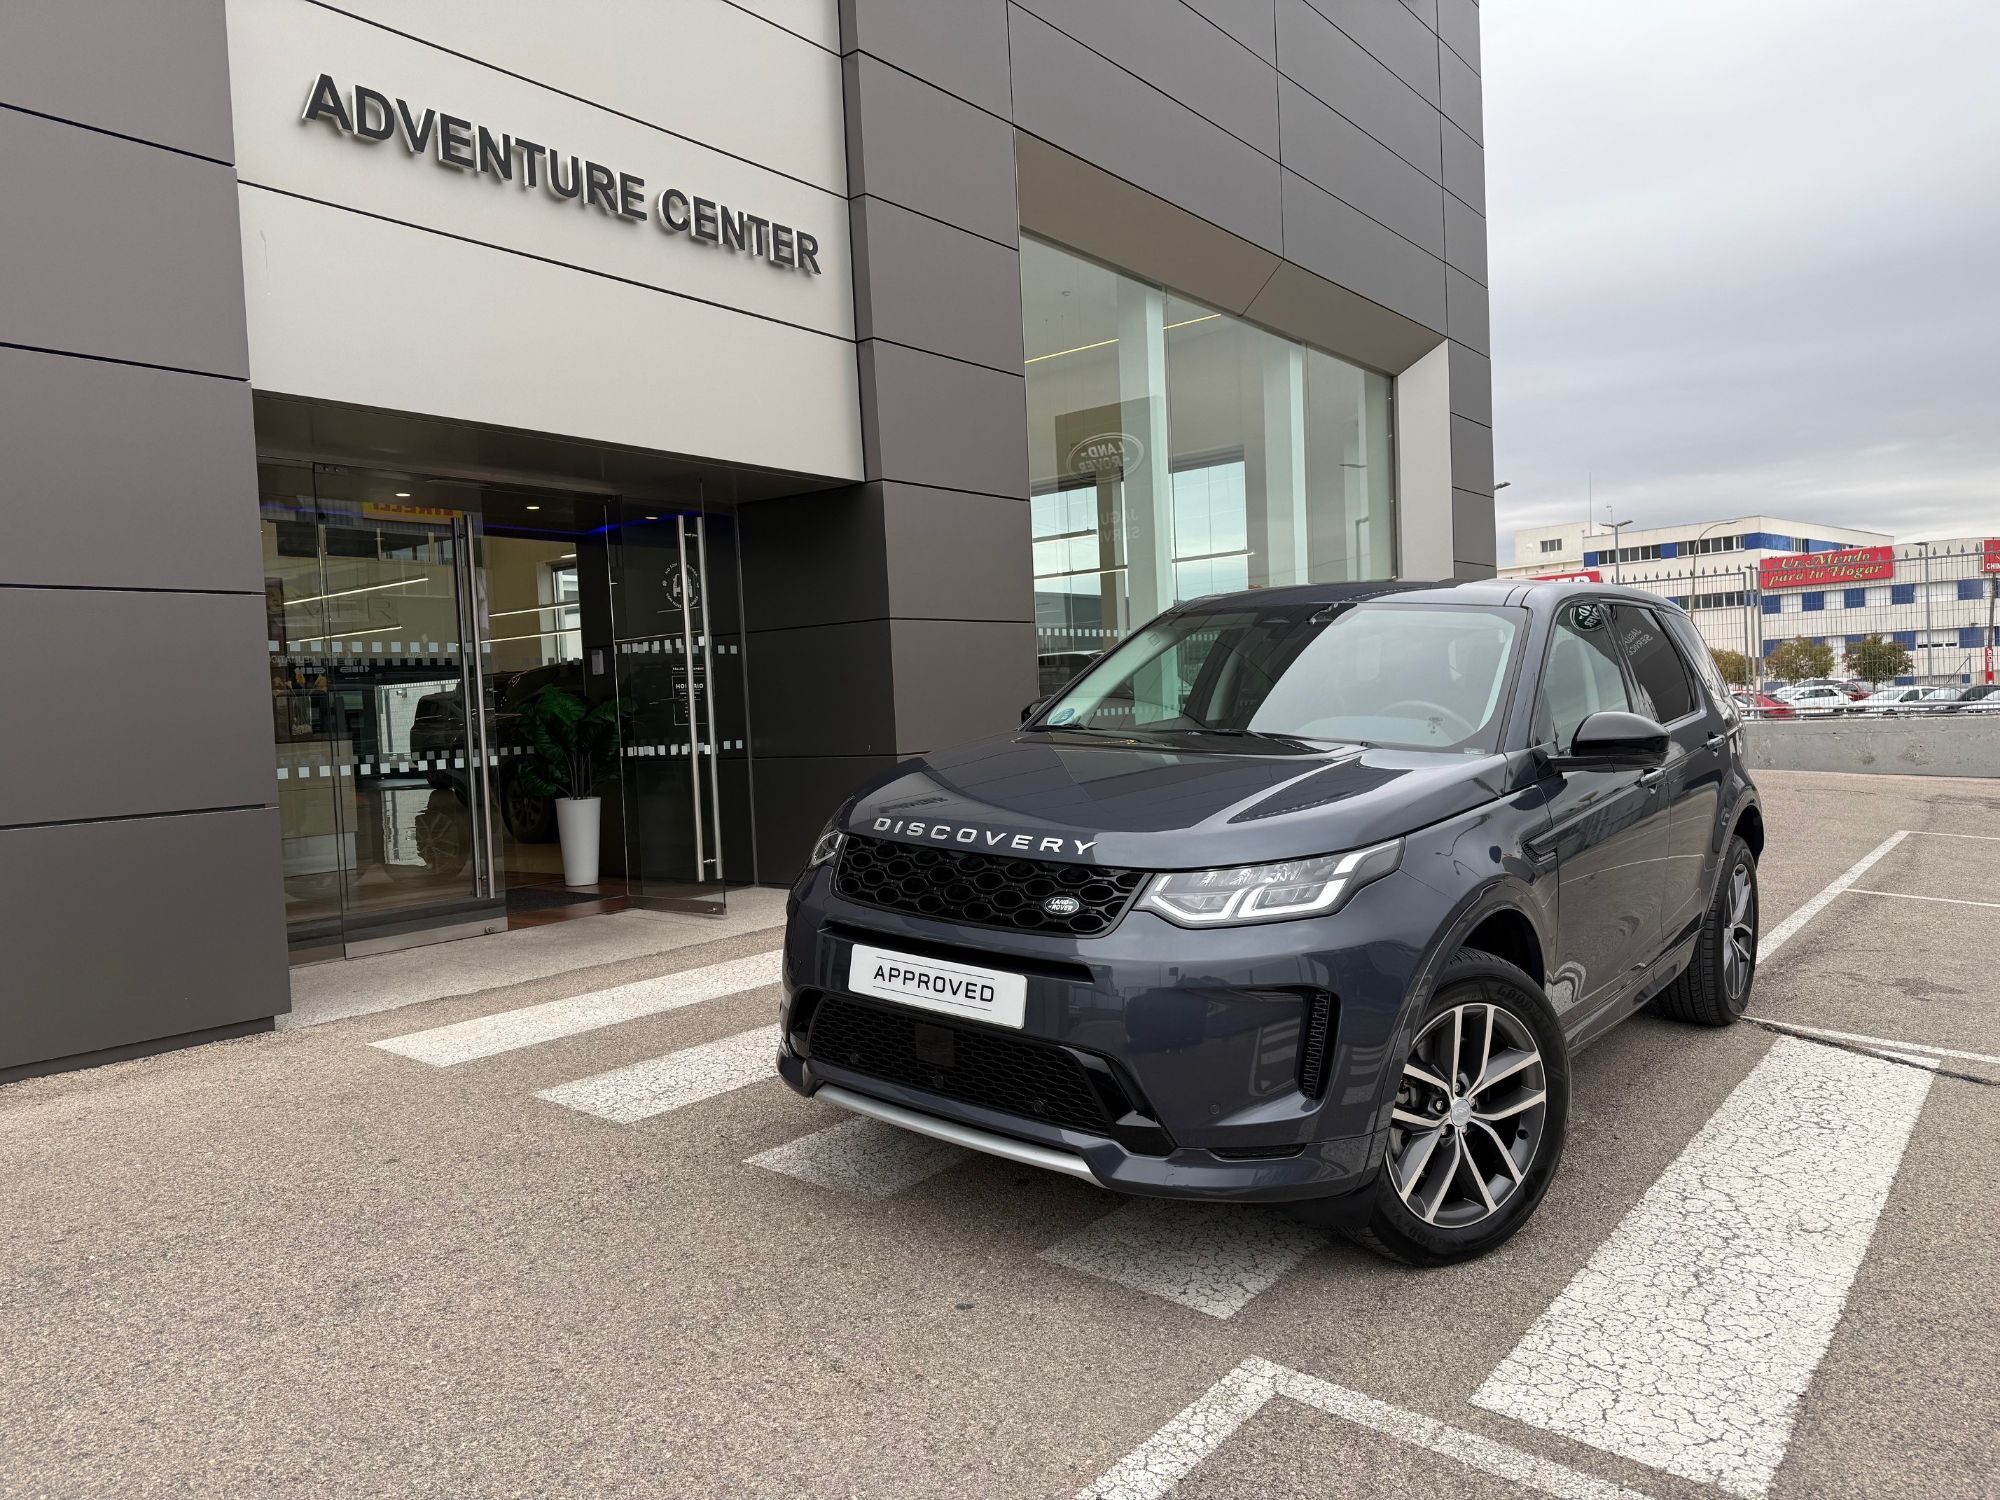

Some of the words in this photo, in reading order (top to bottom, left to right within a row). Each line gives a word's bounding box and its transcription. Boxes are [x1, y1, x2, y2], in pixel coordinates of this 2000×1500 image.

[302, 73, 648, 222] ADVENTURE
[658, 188, 822, 275] CENTER
[872, 817, 1098, 855] DISCOVERY
[873, 964, 995, 1003] APPROVED
